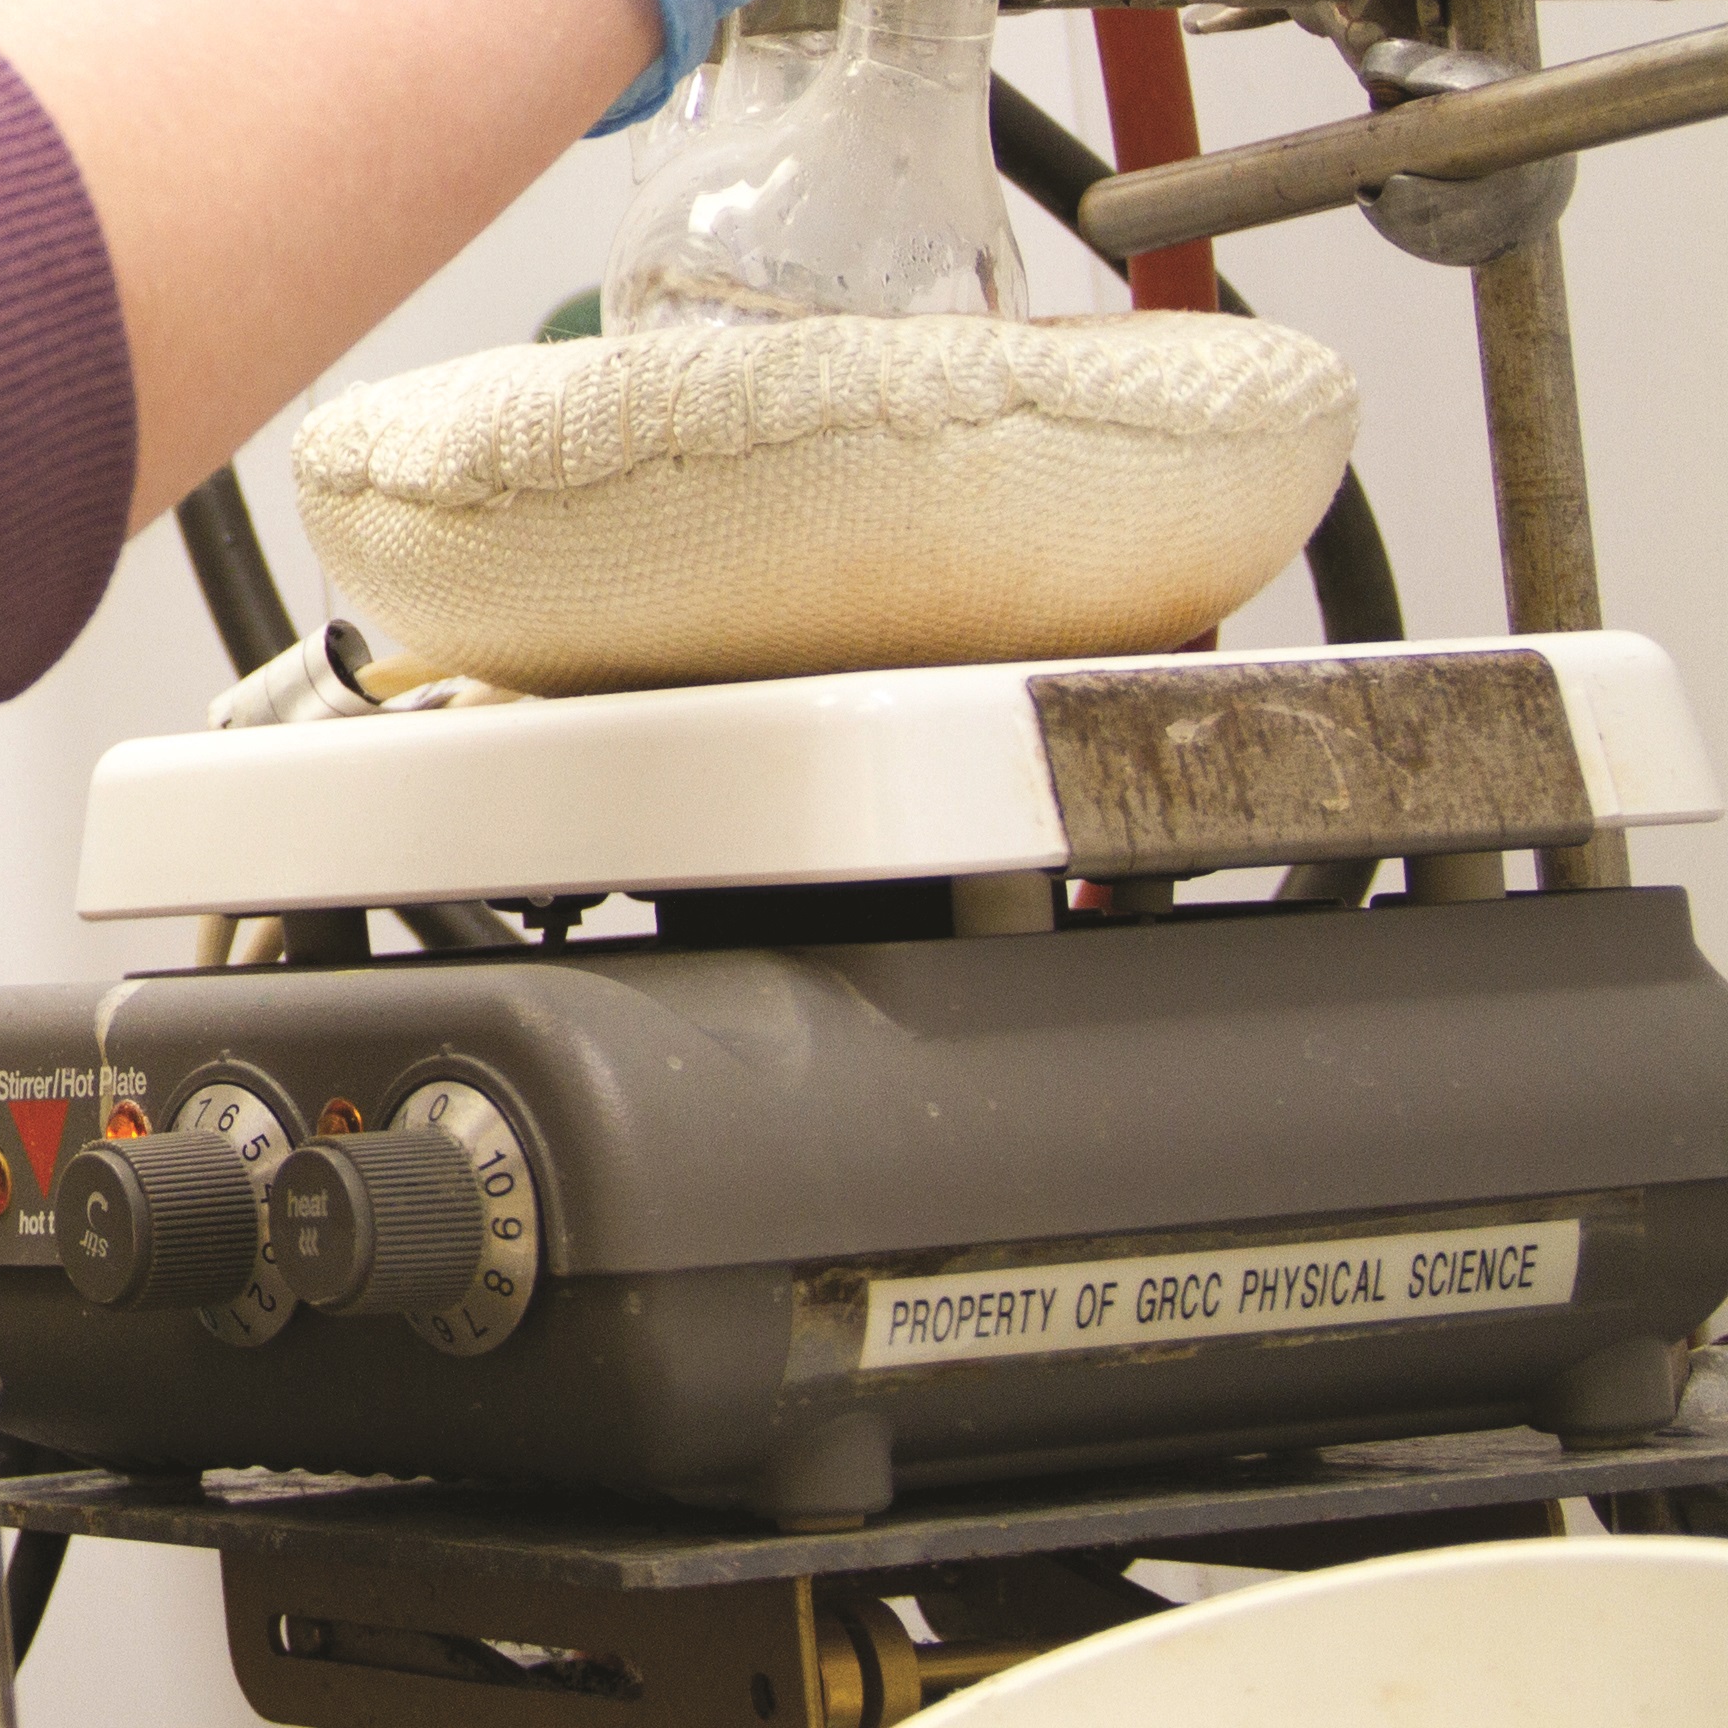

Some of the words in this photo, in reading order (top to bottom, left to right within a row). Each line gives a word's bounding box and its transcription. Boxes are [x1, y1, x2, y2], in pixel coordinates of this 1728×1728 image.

[99, 1066, 147, 1098] Plate
[218, 1103, 239, 1132] 6
[428, 1093, 449, 1122] 0
[242, 1133, 271, 1162] 5
[478, 1149, 514, 1198] 10
[287, 1188, 328, 1217] heat
[19, 1210, 44, 1234] hot
[491, 1216, 523, 1241] 9
[79, 1230, 109, 1258] stir
[248, 1281, 276, 1312] 2
[483, 1269, 514, 1297] 8
[888, 1288, 1057, 1345] PROPERTY
[1076, 1282, 1118, 1329] OF
[1136, 1272, 1222, 1324] GRCC
[1239, 1258, 1386, 1313] PHYSICAL
[1408, 1244, 1539, 1299] SCIENCE
[464, 1308, 489, 1339] 7
